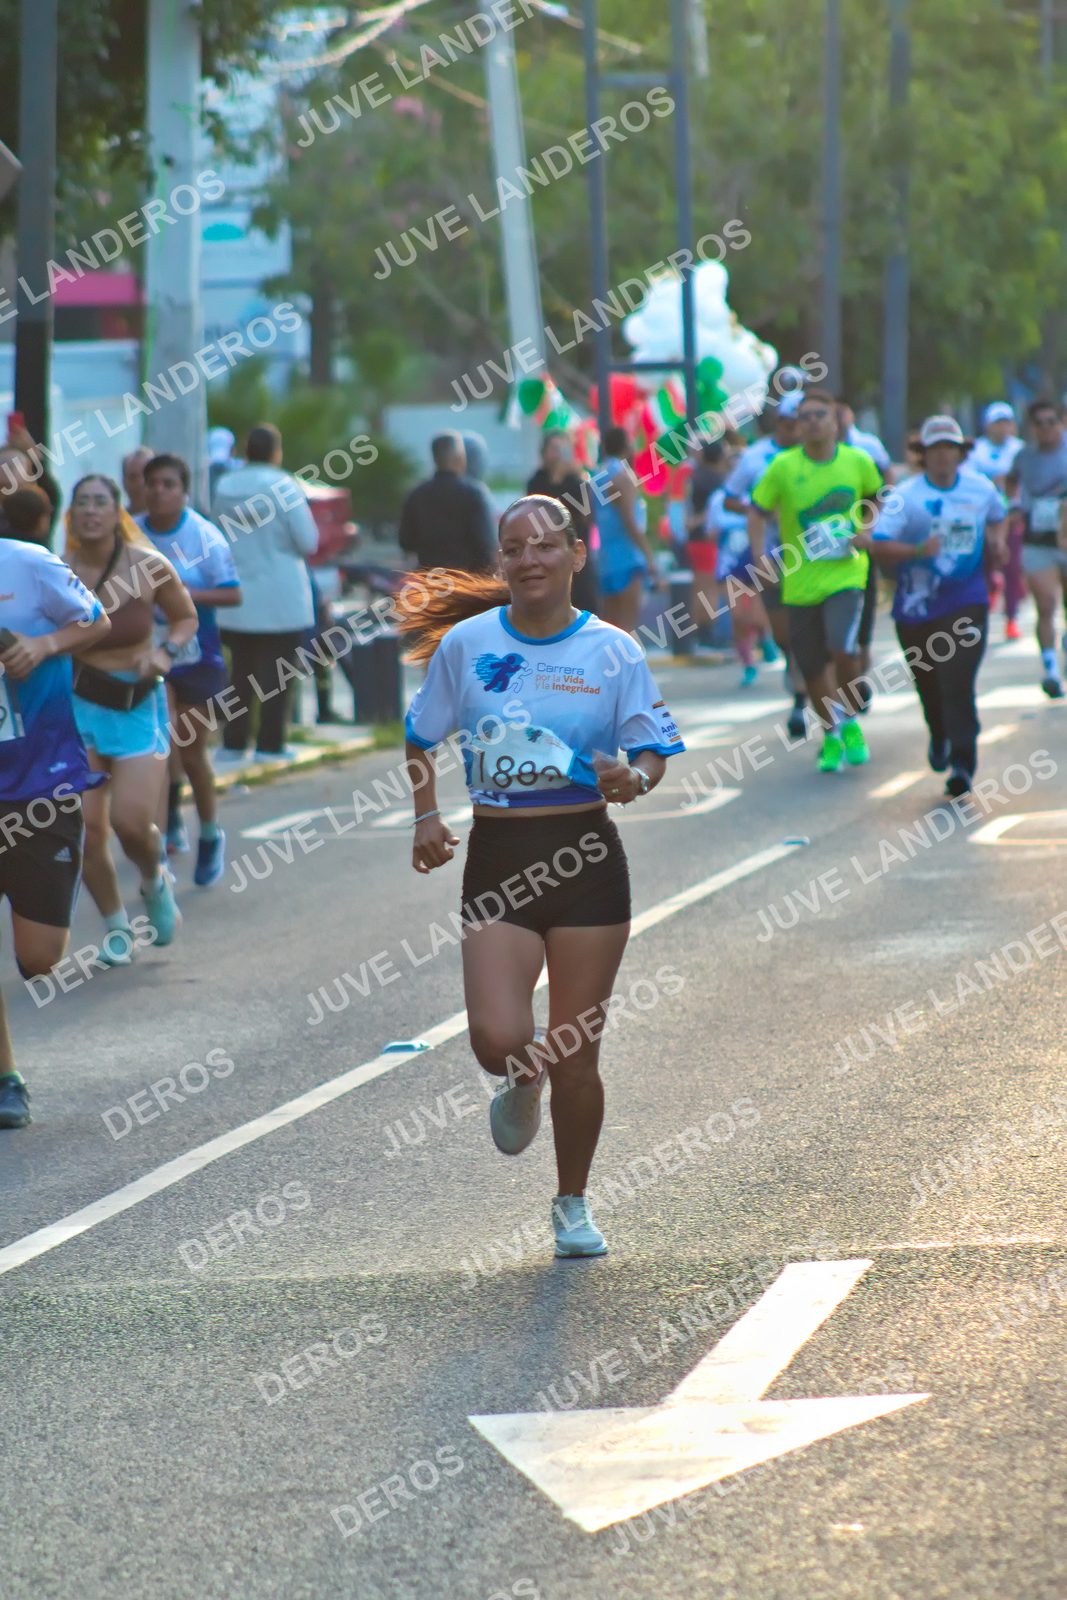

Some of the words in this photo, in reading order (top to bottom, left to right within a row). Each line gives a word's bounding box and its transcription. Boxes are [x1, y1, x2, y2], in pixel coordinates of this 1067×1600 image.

[537, 663, 584, 675] Carrera
[535, 674, 550, 682] por
[563, 675, 584, 684] Vida
